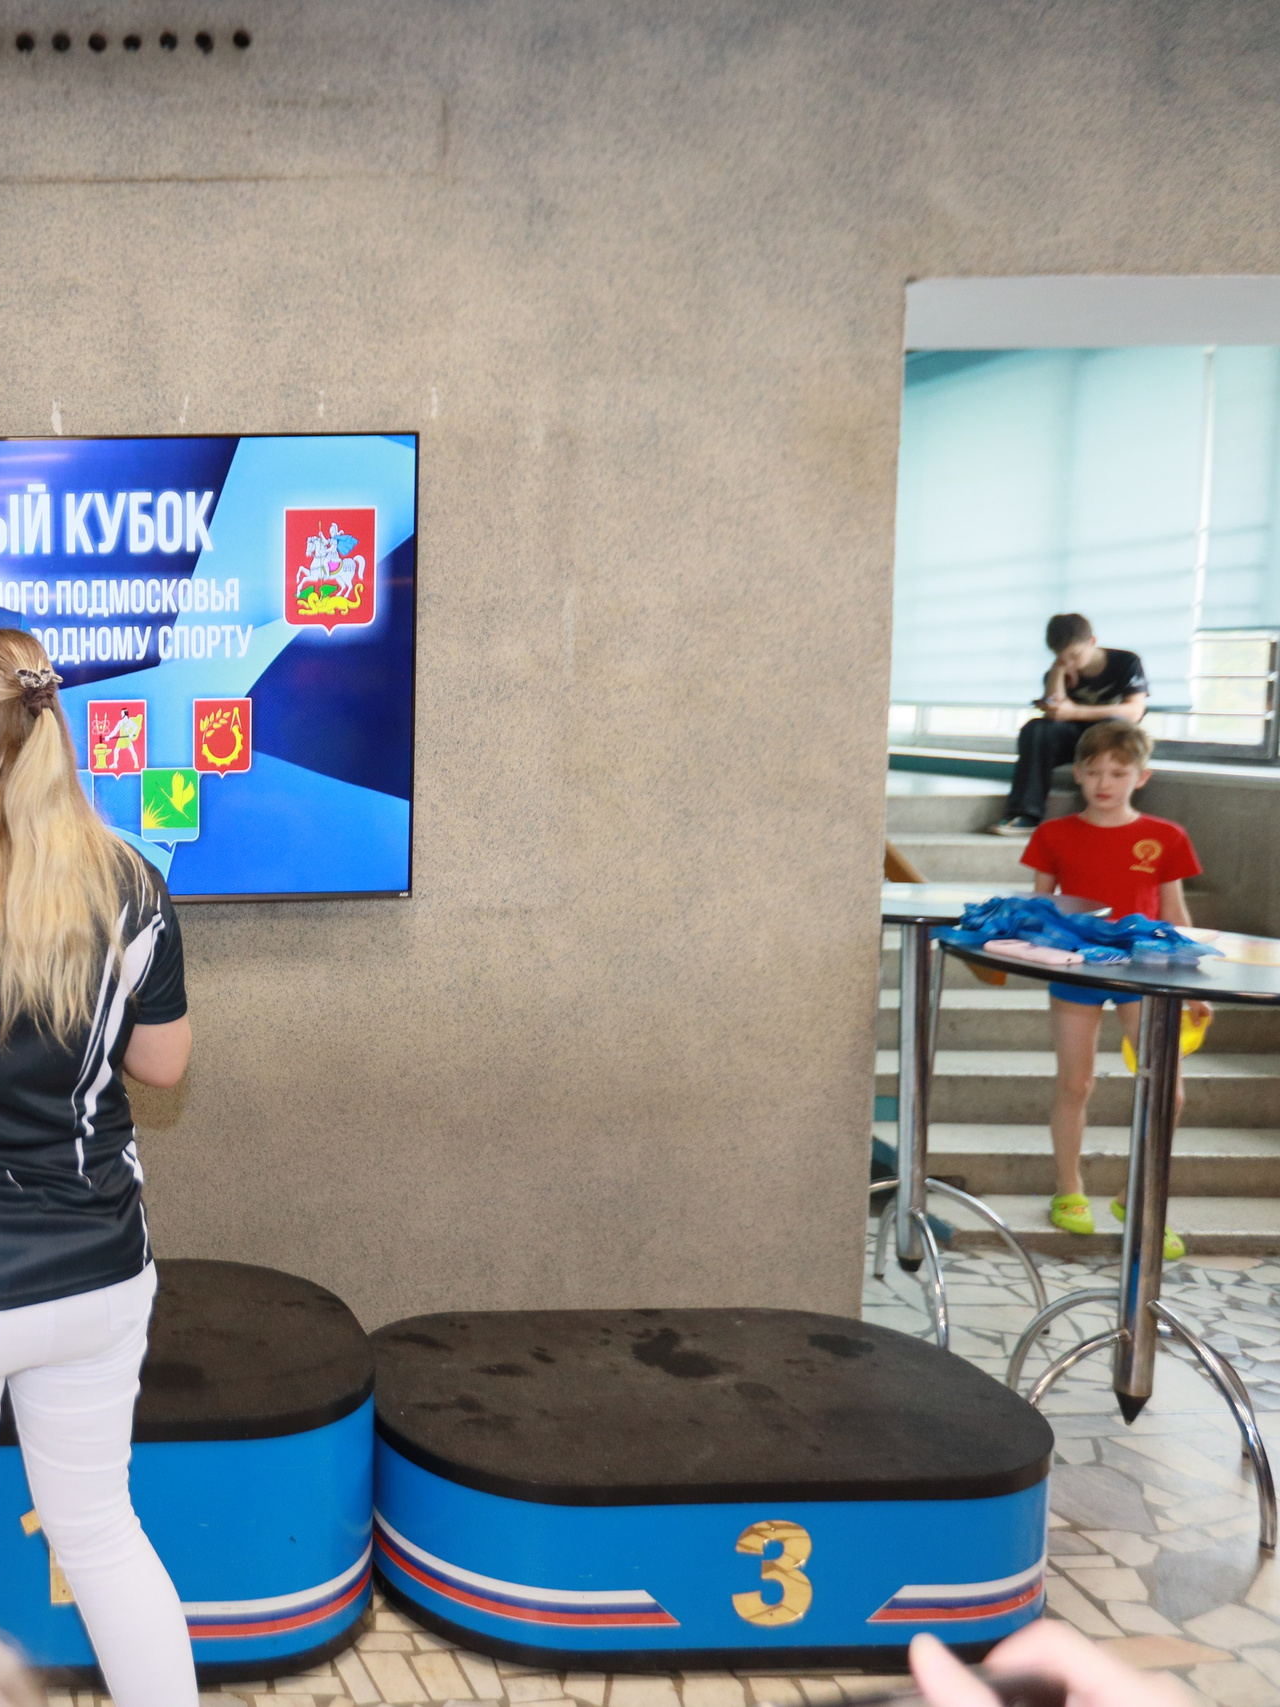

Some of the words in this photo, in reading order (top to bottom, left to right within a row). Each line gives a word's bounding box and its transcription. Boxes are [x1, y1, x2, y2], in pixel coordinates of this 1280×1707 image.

[66, 490, 214, 555] КУБОК
[56, 577, 240, 618] ПОДМОСКОВЬЯ
[31, 625, 152, 665] ОДНОМУ
[158, 624, 253, 660] СПОРТУ
[732, 1520, 813, 1626] 3
